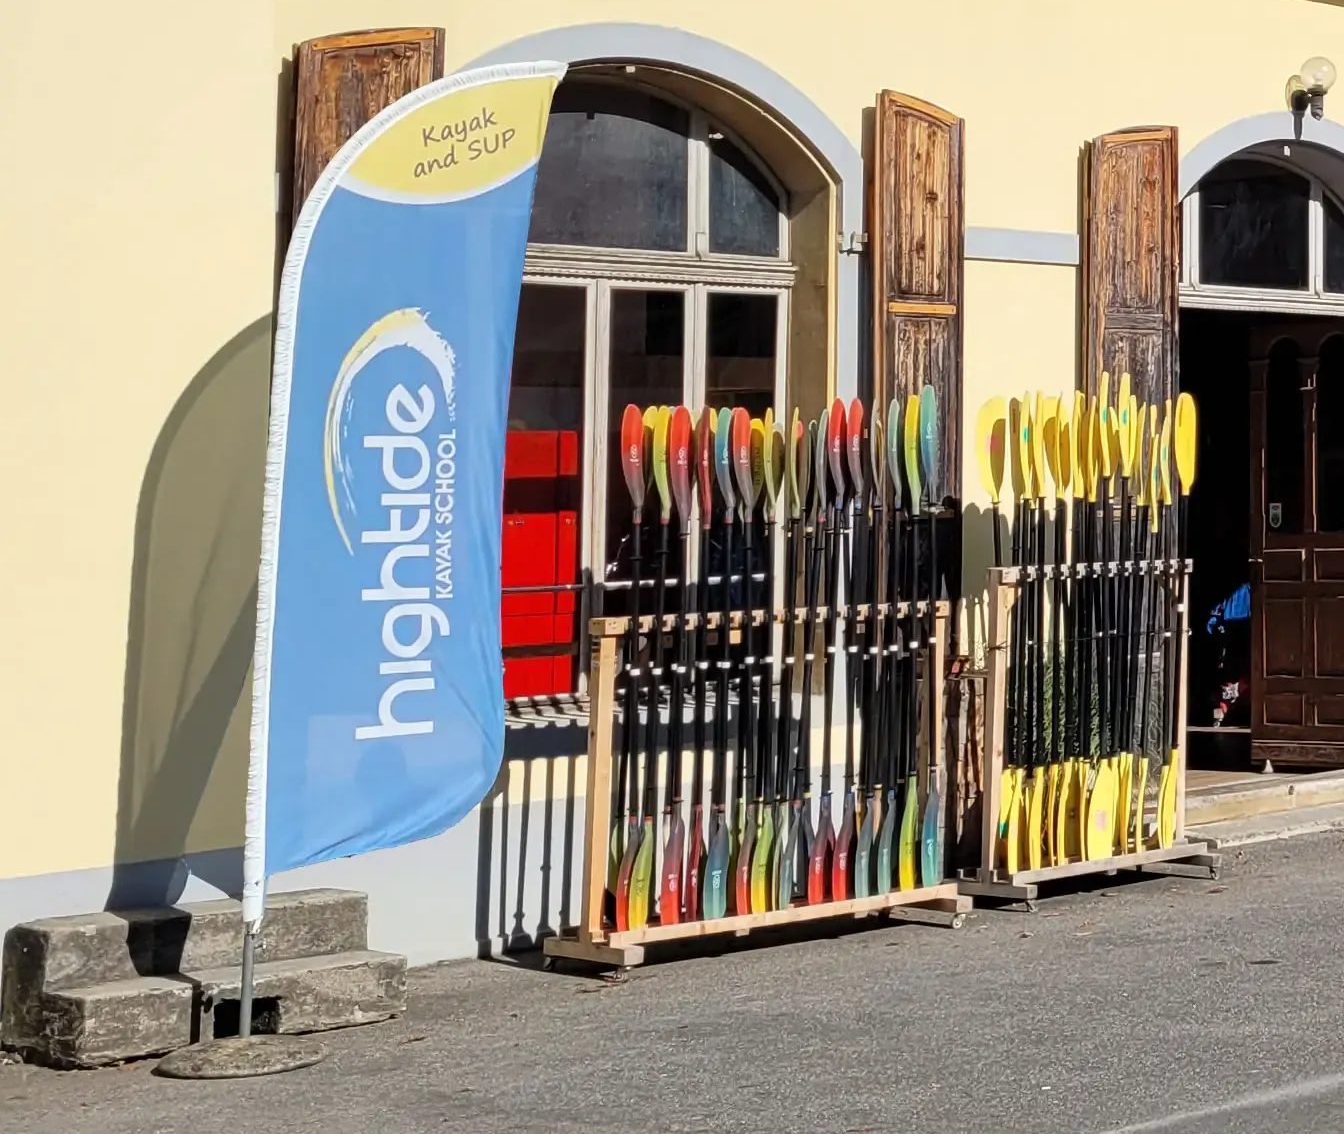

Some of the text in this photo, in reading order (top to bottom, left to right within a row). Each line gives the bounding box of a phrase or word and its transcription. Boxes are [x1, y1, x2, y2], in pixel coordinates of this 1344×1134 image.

[413, 128, 516, 178] and SUP
[422, 107, 498, 147] Kayak
[355, 382, 451, 740] hightide
[435, 427, 456, 599] KAYAK SCHOOL
